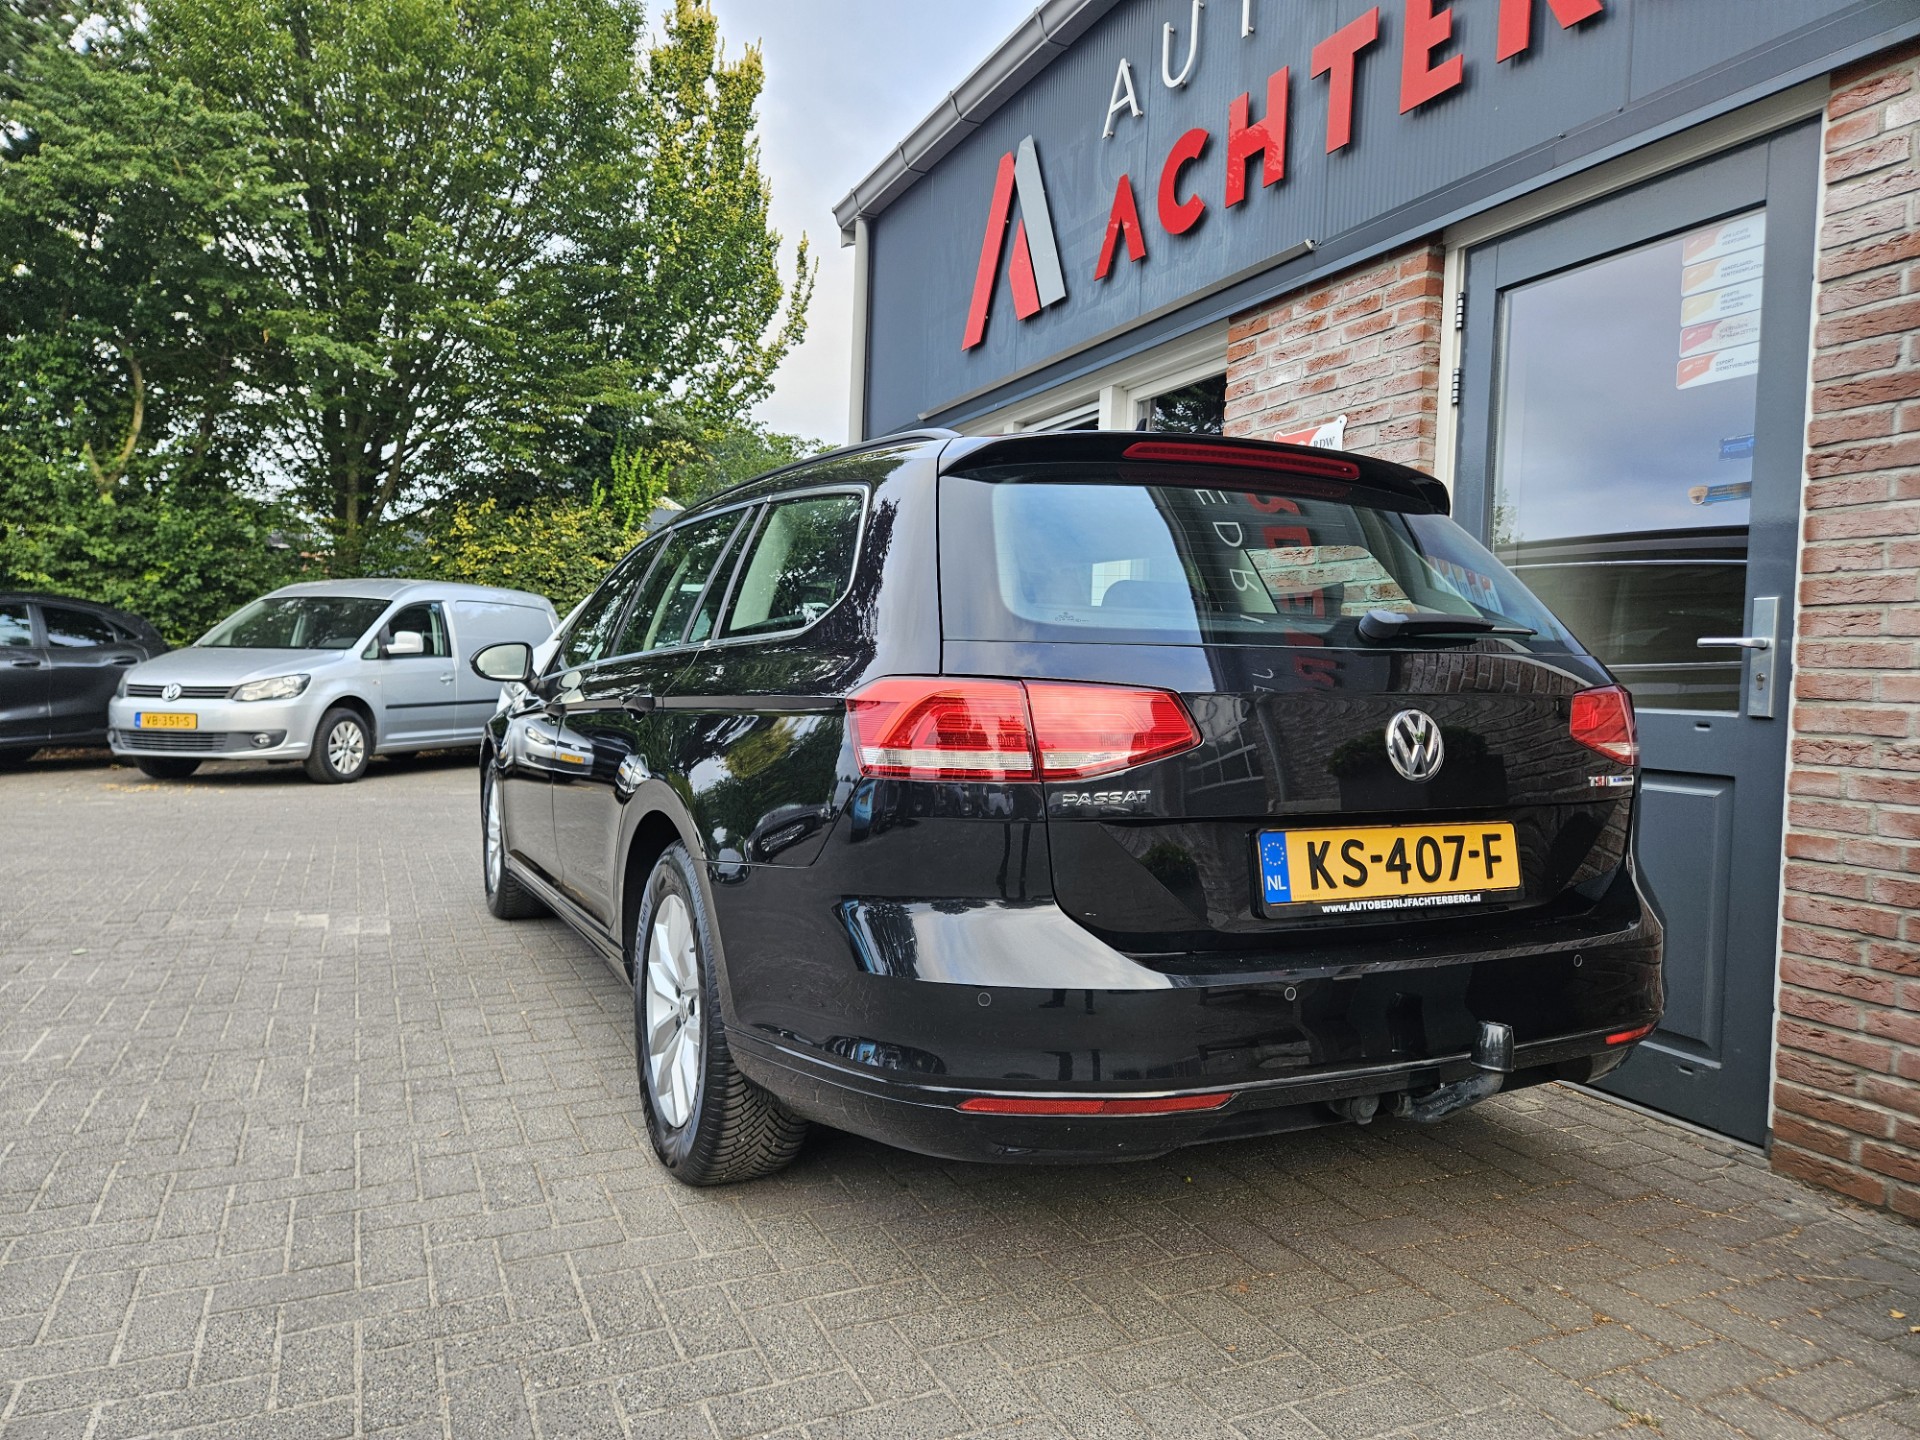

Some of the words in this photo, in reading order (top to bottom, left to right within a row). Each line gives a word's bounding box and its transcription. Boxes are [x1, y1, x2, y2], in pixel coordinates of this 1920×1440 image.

[145, 715, 190, 727] VB-351-S
[1062, 790, 1151, 806] PASSAT
[1307, 833, 1502, 890] KS-407-F
[1267, 875, 1287, 890] NL
[1322, 893, 1481, 913] www.AUTOBEDRIJFACHTERBERG.nl
